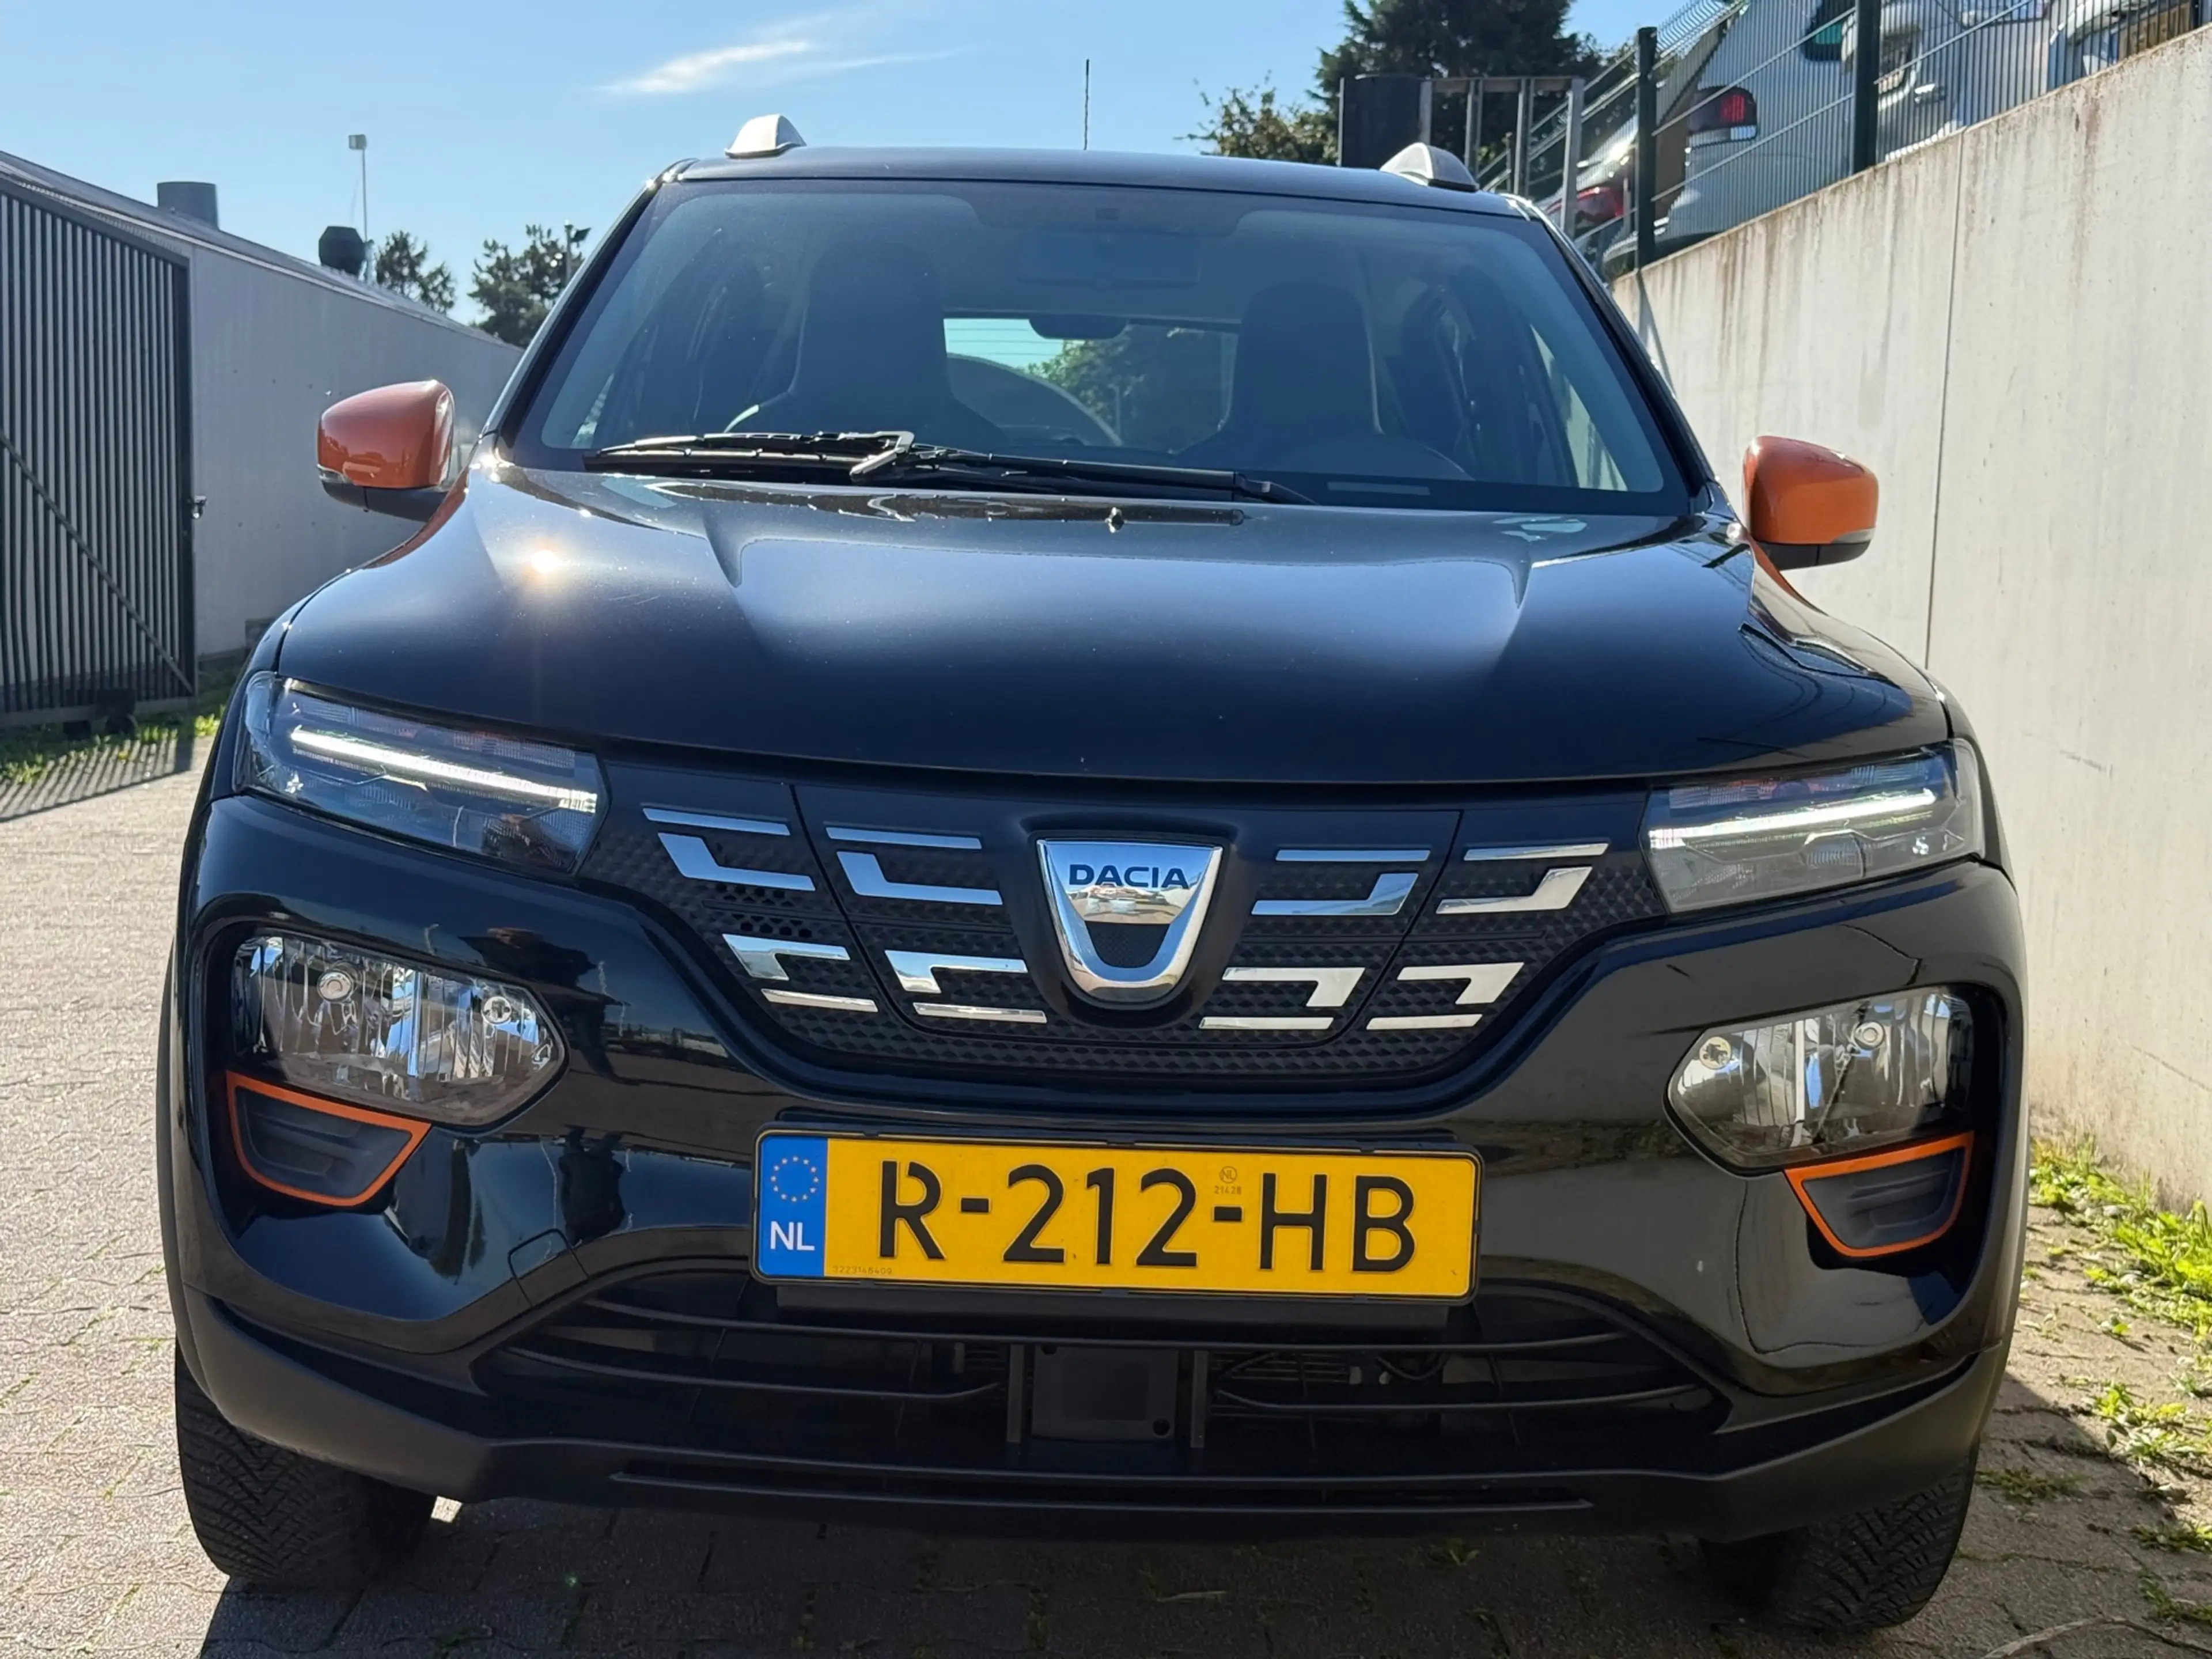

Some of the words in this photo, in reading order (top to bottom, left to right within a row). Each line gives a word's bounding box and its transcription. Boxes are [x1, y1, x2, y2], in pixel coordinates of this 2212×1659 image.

[1069, 863, 1189, 889] DACIA
[880, 1160, 1415, 1272] R-212-HB
[770, 1221, 815, 1251] NL
